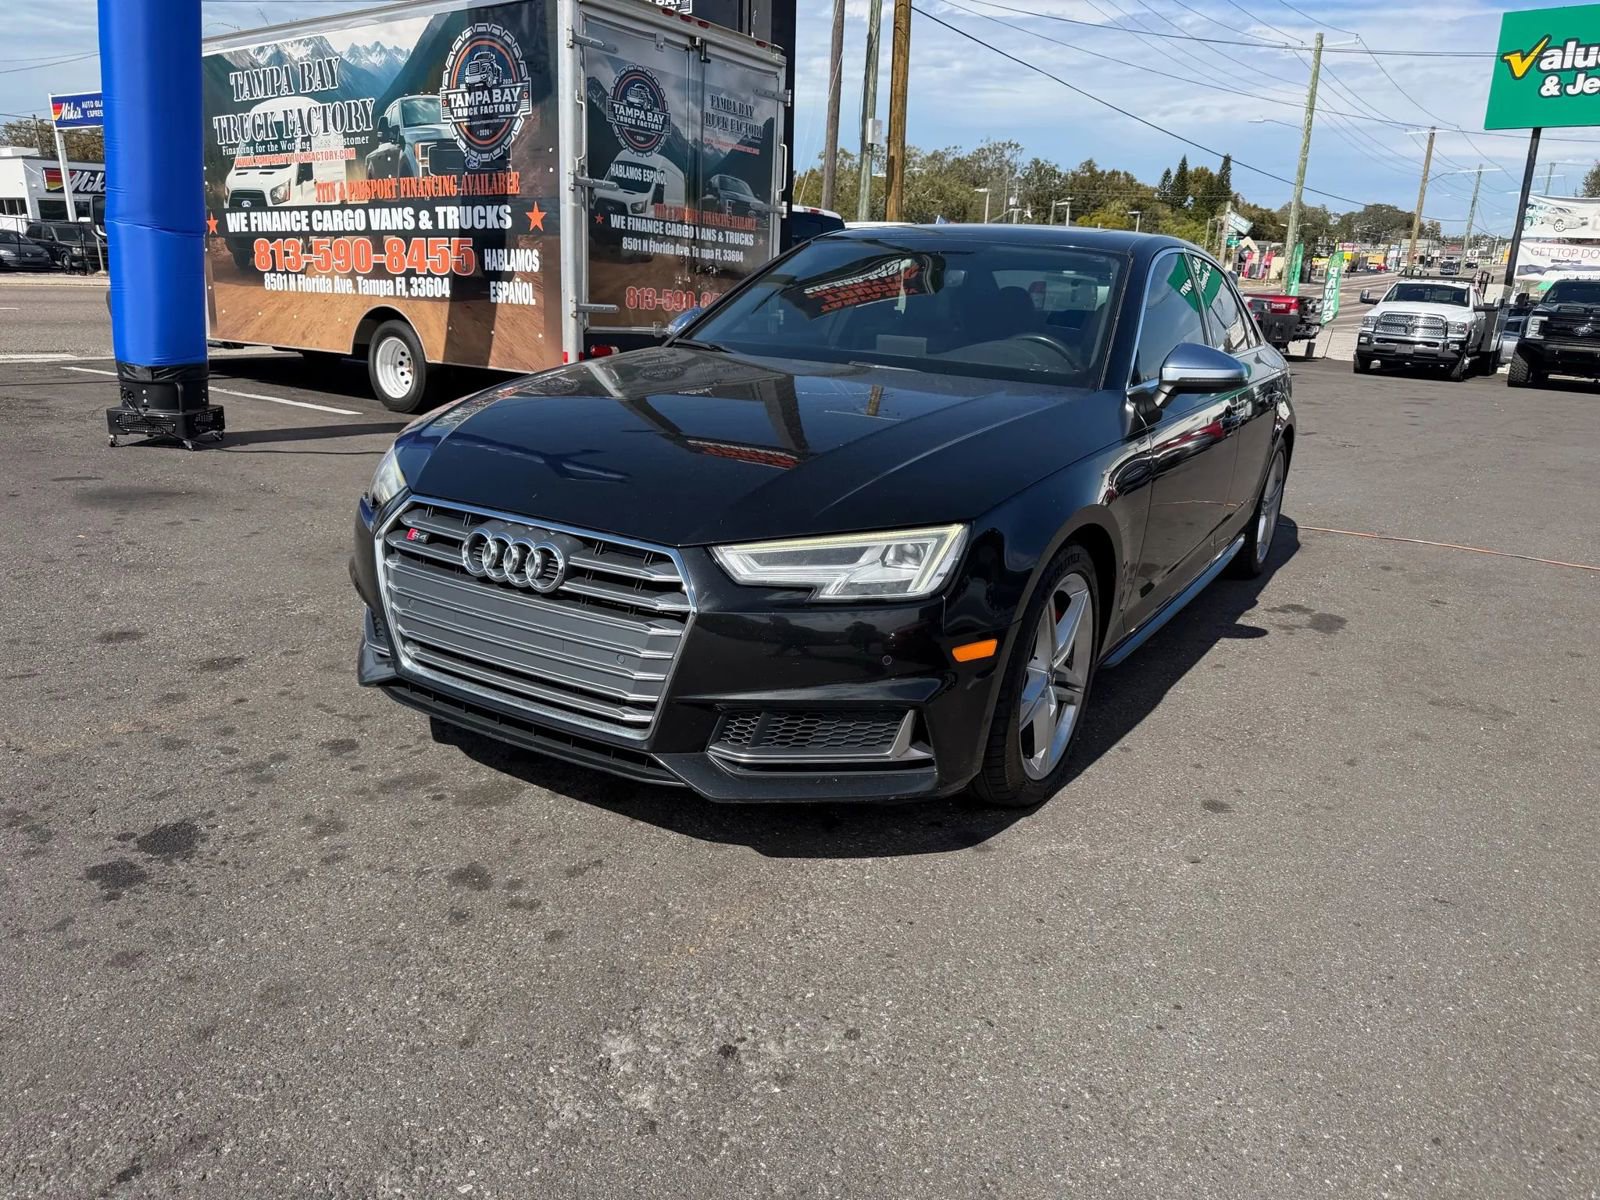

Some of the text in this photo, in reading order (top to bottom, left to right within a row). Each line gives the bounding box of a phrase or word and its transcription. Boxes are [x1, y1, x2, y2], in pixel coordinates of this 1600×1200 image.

[230, 56, 340, 102] TAMPA BAY
[1540, 75, 1560, 96] &
[448, 87, 521, 108] TAMPA BAY
[453, 103, 517, 117] TRUCK FACTORY
[62, 102, 83, 120] Mike's
[212, 98, 375, 145] TRUCK FACTORY
[613, 103, 665, 125] TAMPA BAY
[616, 114, 636, 124] TRUCK
[637, 119, 662, 131] FACTORY
[222, 143, 254, 156] Financing
[256, 142, 267, 153] for
[267, 141, 279, 152] the
[610, 162, 642, 180] HABLAMOS
[348, 177, 397, 202] PASSPORT
[400, 174, 458, 199] FINANCING
[460, 171, 520, 197] AVAILABLE
[226, 205, 512, 233] WE FINANCE CARGO VANS & TRUCKS
[610, 213, 627, 229] WE
[627, 216, 664, 234] FINANCE
[665, 222, 694, 239] CARGO
[717, 231, 724, 242] &
[725, 230, 754, 247] TRUCKS
[253, 237, 475, 276] 813-590-8455
[484, 248, 540, 273] HABLAMOS
[622, 236, 642, 251] 8501
[642, 240, 648, 252] N
[649, 240, 675, 256] Florida
[723, 249, 744, 262] 33604
[1531, 247, 1555, 257] GET
[1556, 247, 1579, 258] TOP
[264, 272, 288, 291] 8501
[288, 273, 297, 291] N
[297, 274, 332, 293] Florida
[333, 275, 356, 294] Ave.
[356, 276, 395, 298] Tampa
[410, 277, 450, 298] 33604
[489, 279, 536, 306] ESPAÑOL
